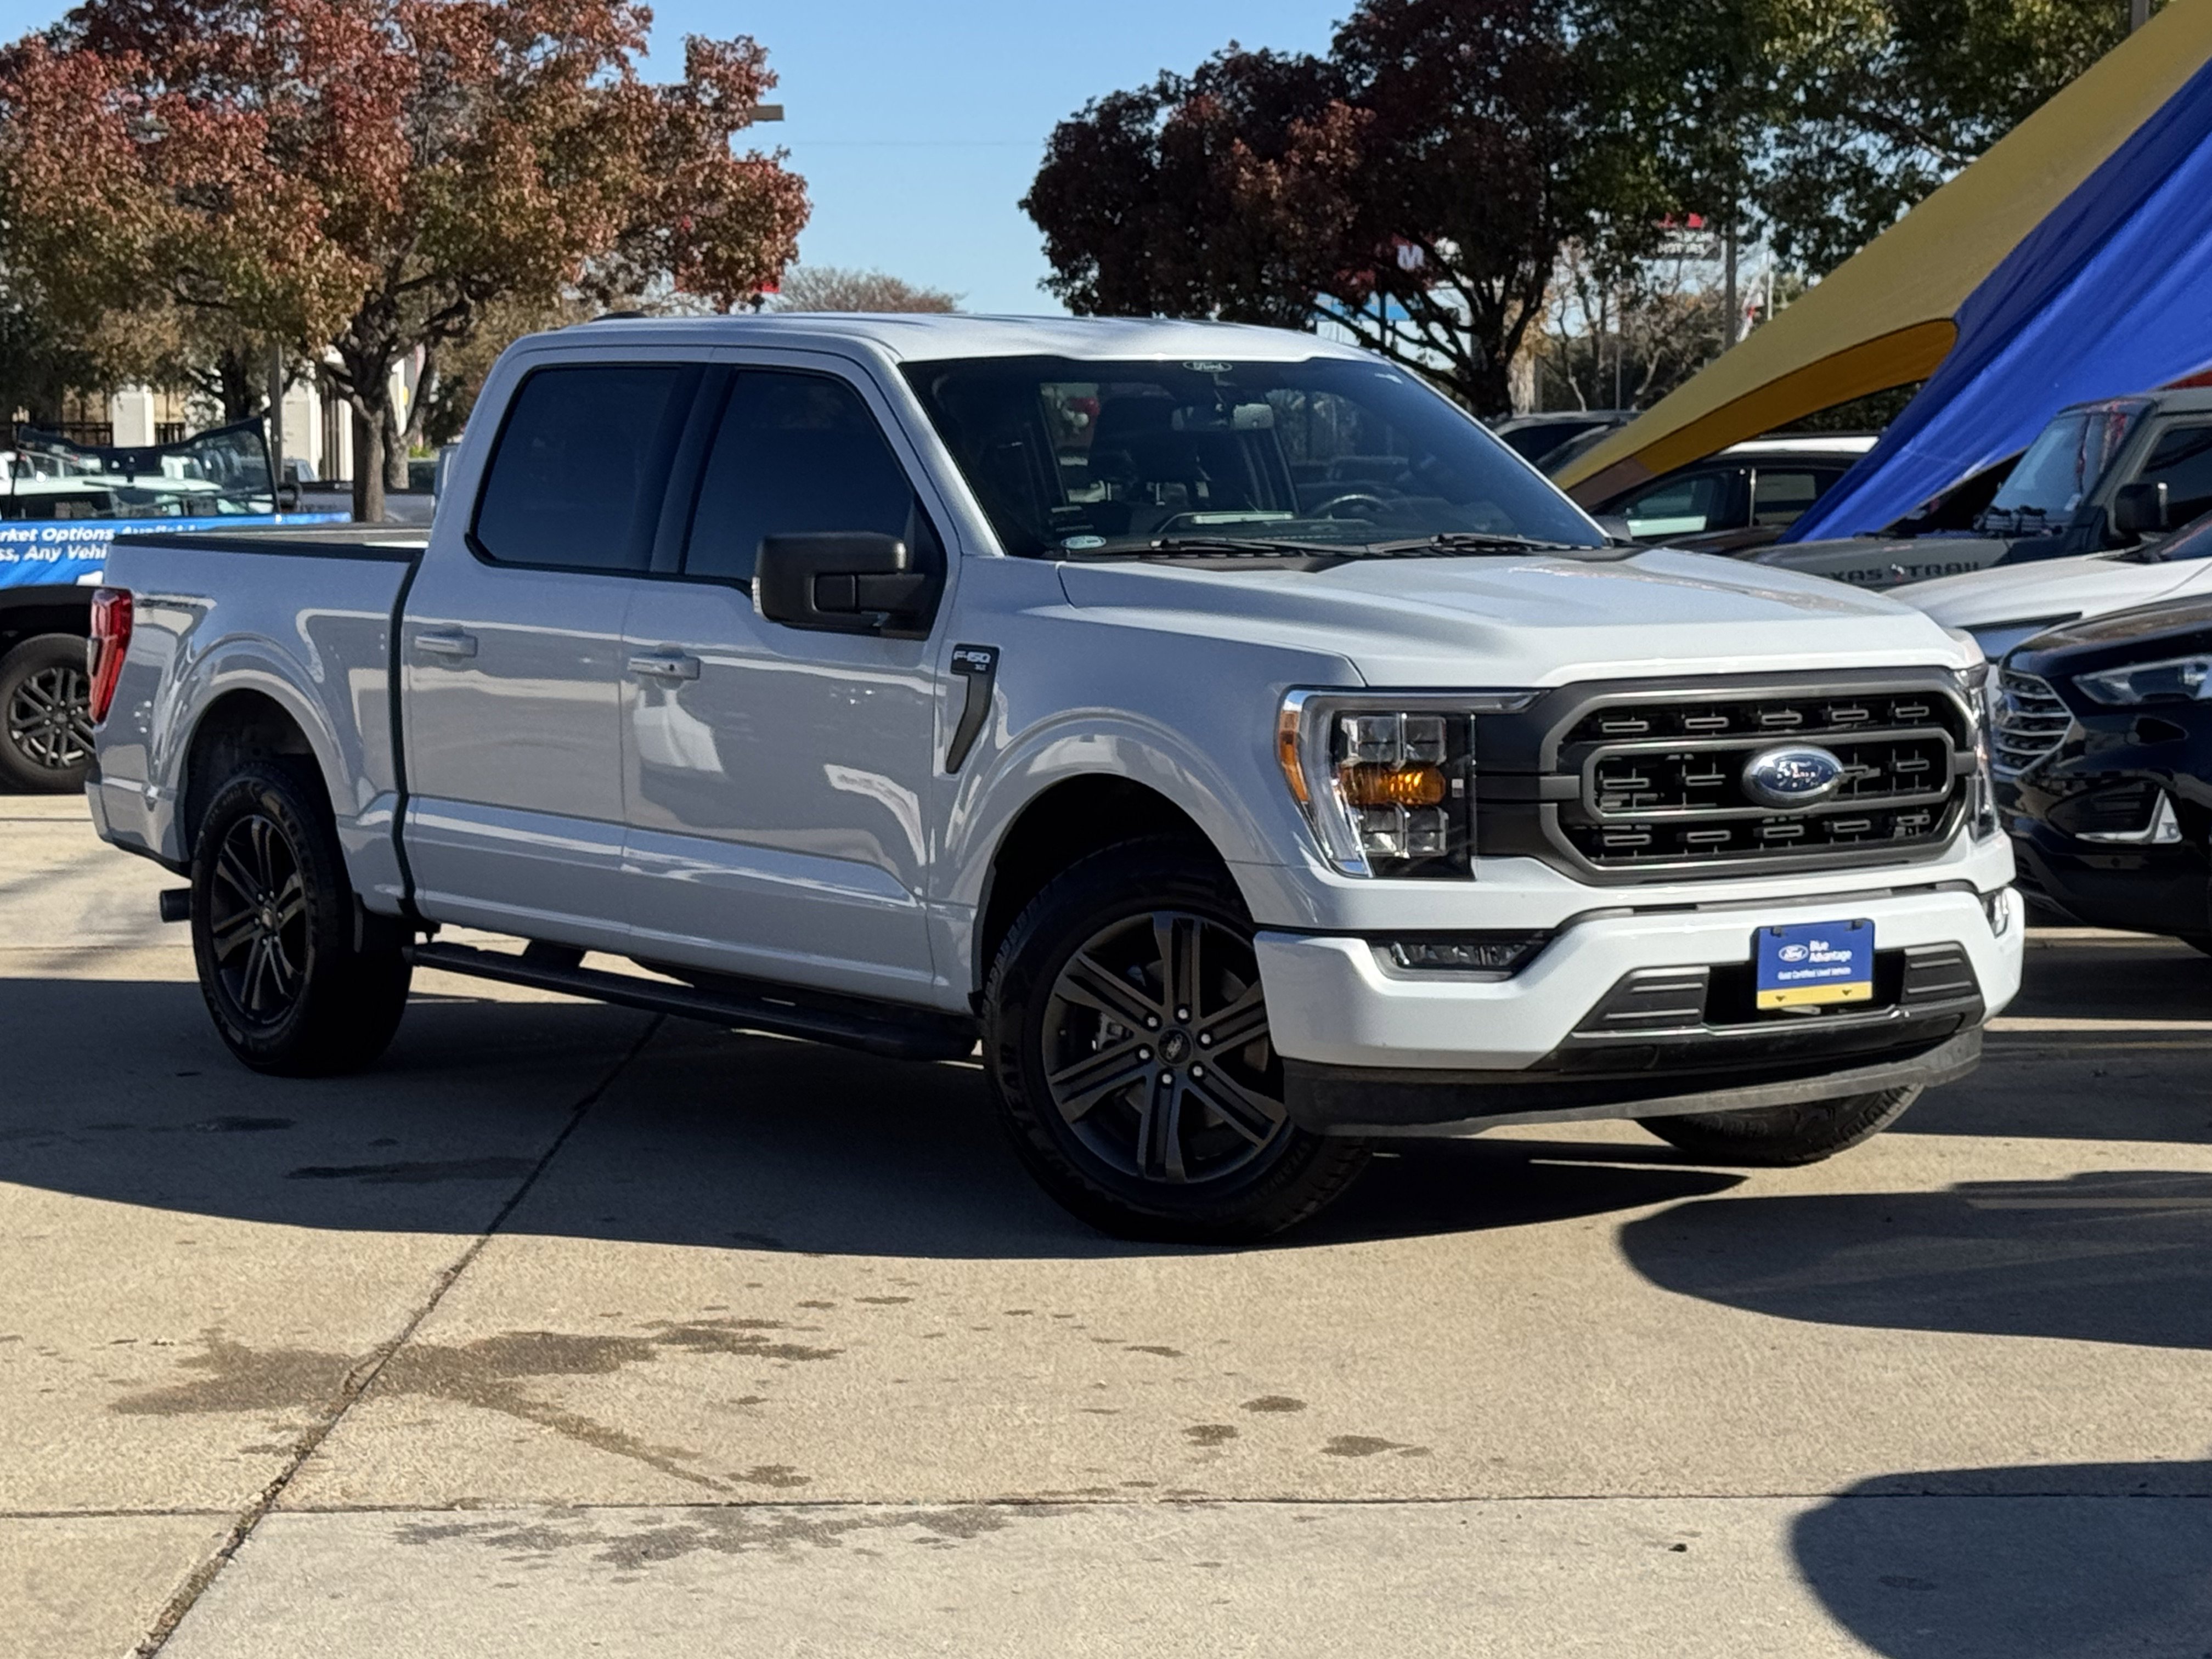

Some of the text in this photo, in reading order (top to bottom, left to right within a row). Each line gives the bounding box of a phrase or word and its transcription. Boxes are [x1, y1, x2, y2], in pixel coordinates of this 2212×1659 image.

[42, 527, 115, 544] Options
[22, 545, 62, 563] Any
[953, 651, 991, 663] F-150
